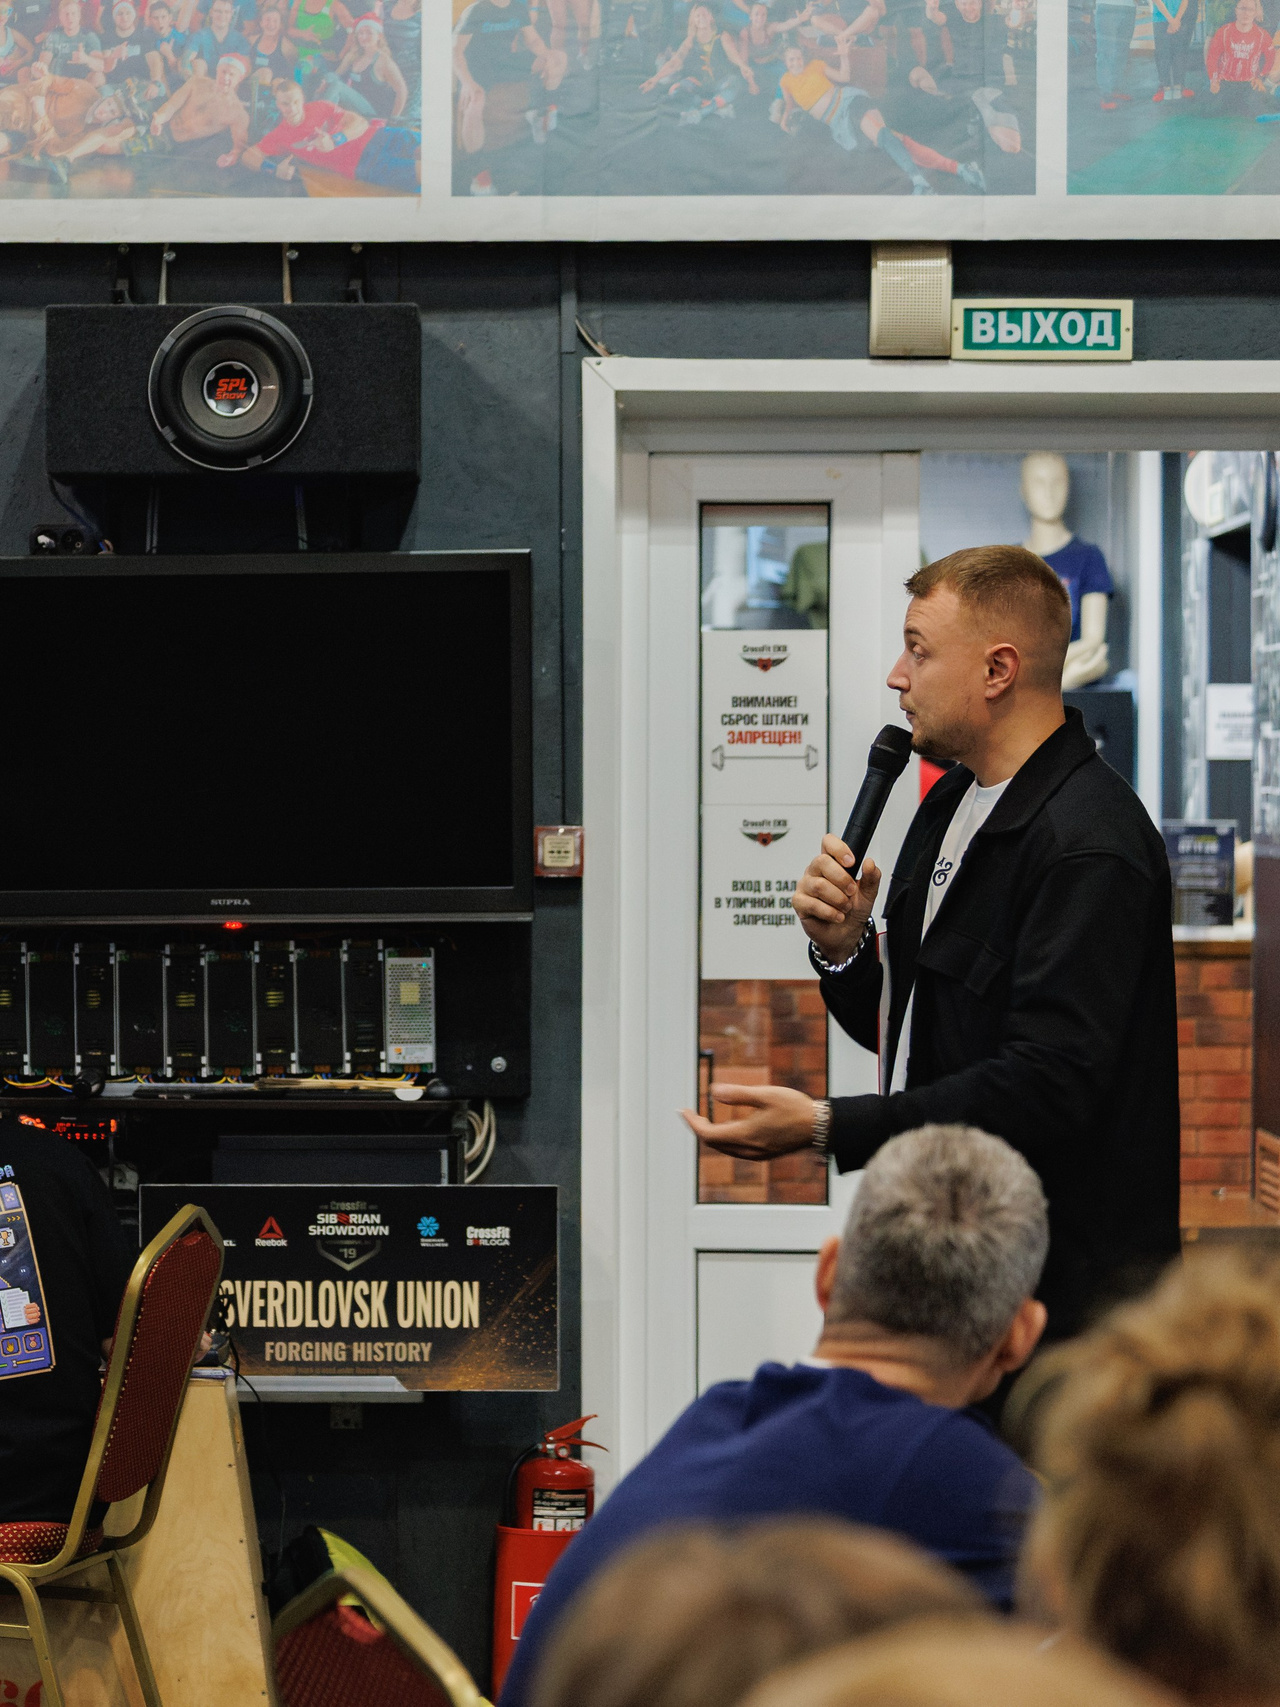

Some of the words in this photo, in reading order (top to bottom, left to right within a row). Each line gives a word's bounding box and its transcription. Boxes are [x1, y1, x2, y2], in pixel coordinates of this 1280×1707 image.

[971, 310, 1115, 347] ВЫХОД
[216, 377, 248, 392] SPL
[215, 391, 247, 401] Show
[731, 695, 798, 708] ВНИМАНИЕ!
[721, 713, 759, 726] СБРОС
[762, 713, 809, 726] ШТАНГИ
[727, 730, 802, 746] ЗАПРЕЩЕН!
[732, 880, 761, 893] ВХОД
[765, 880, 772, 892] В
[775, 880, 797, 892] ЗАЛ
[210, 898, 251, 906] SUPRA
[714, 897, 722, 909] В
[725, 895, 775, 909] УЛИЧНОЙ
[733, 913, 796, 927] ЗАПРЕЩЕН!
[330, 1200, 368, 1211] CrossFit
[308, 1225, 390, 1236] SHOWDOWN
[466, 1226, 511, 1239] CrossFit
[255, 1238, 288, 1247] Reebok
[466, 1238, 511, 1247] BRLOGA
[396, 1280, 481, 1329] UNION
[264, 1341, 347, 1363] FORGING
[352, 1341, 433, 1363] HISTORY
